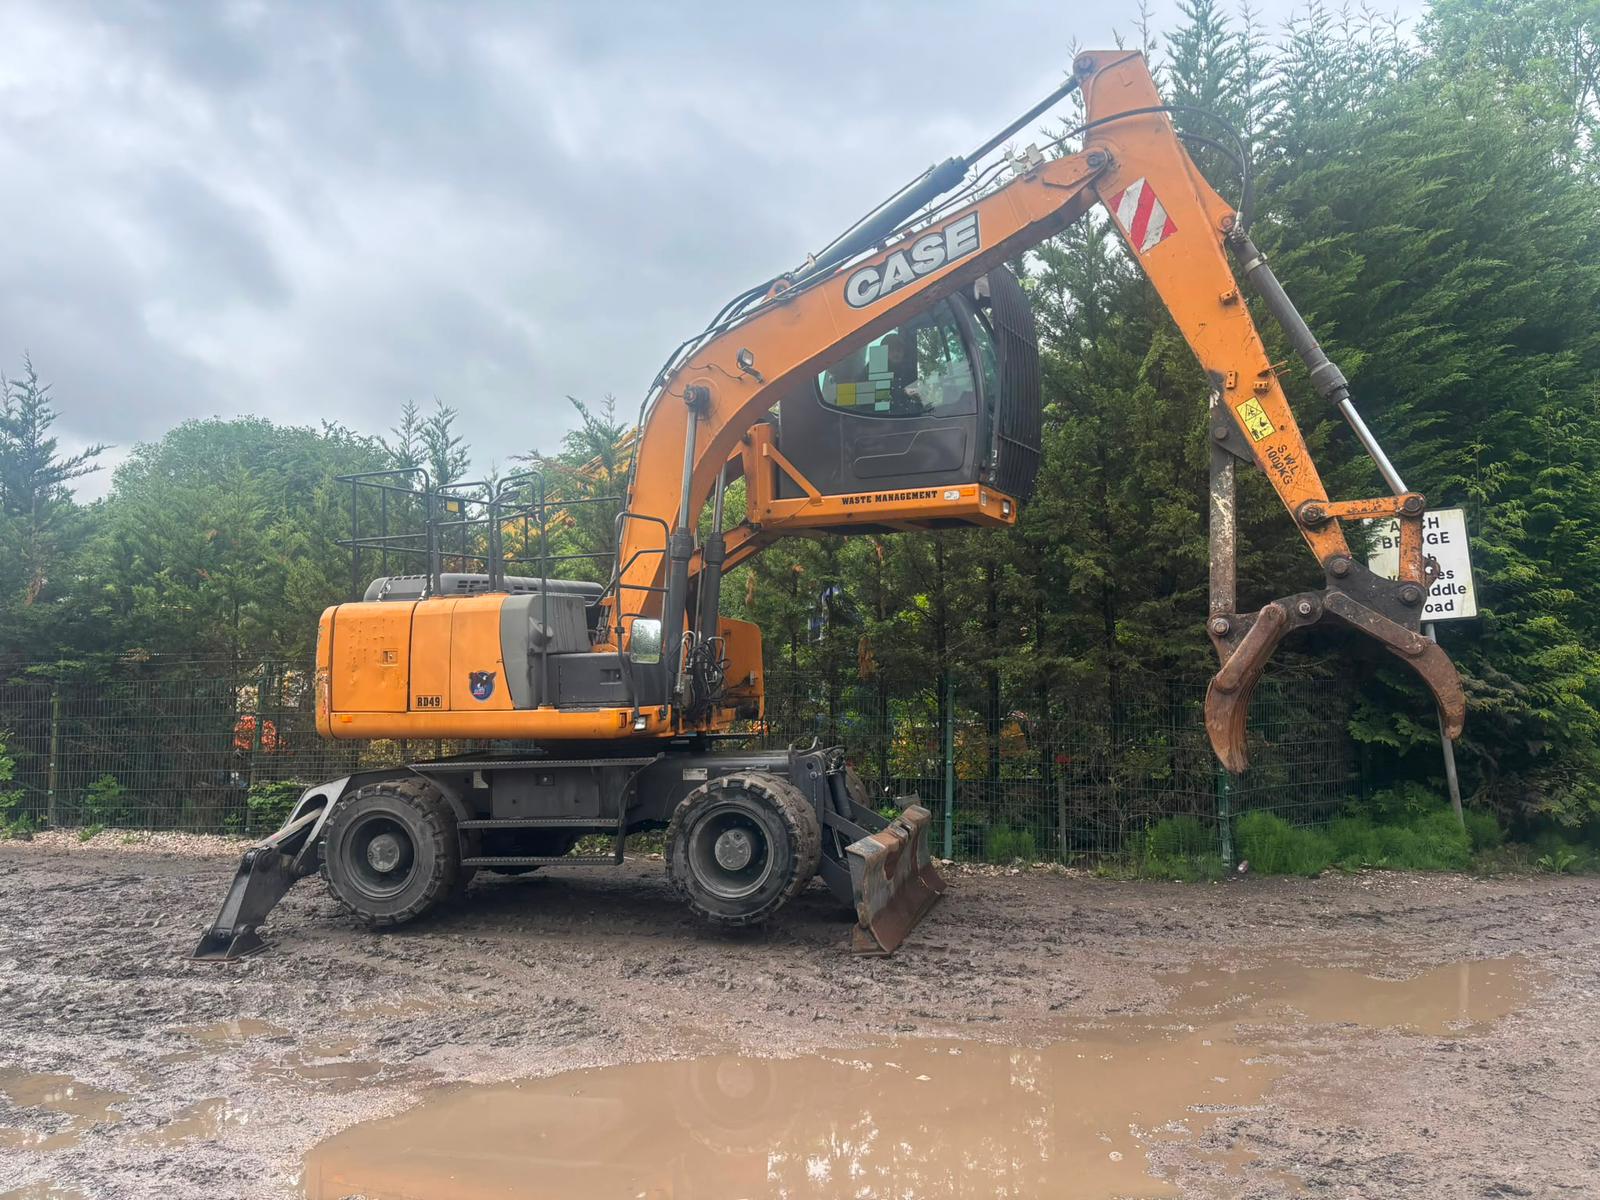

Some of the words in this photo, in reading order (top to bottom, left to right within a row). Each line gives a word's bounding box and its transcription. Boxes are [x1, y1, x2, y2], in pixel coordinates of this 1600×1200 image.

[844, 210, 979, 308] CASE
[1265, 445, 1293, 485] 1000KG
[841, 496, 872, 505] WASTE
[875, 490, 938, 503] MANAGEMENT
[1390, 517, 1440, 532] AH
[1382, 531, 1450, 549] BGE
[1427, 583, 1467, 597] iddle
[1424, 599, 1454, 613] oad
[417, 696, 441, 707] RD49
